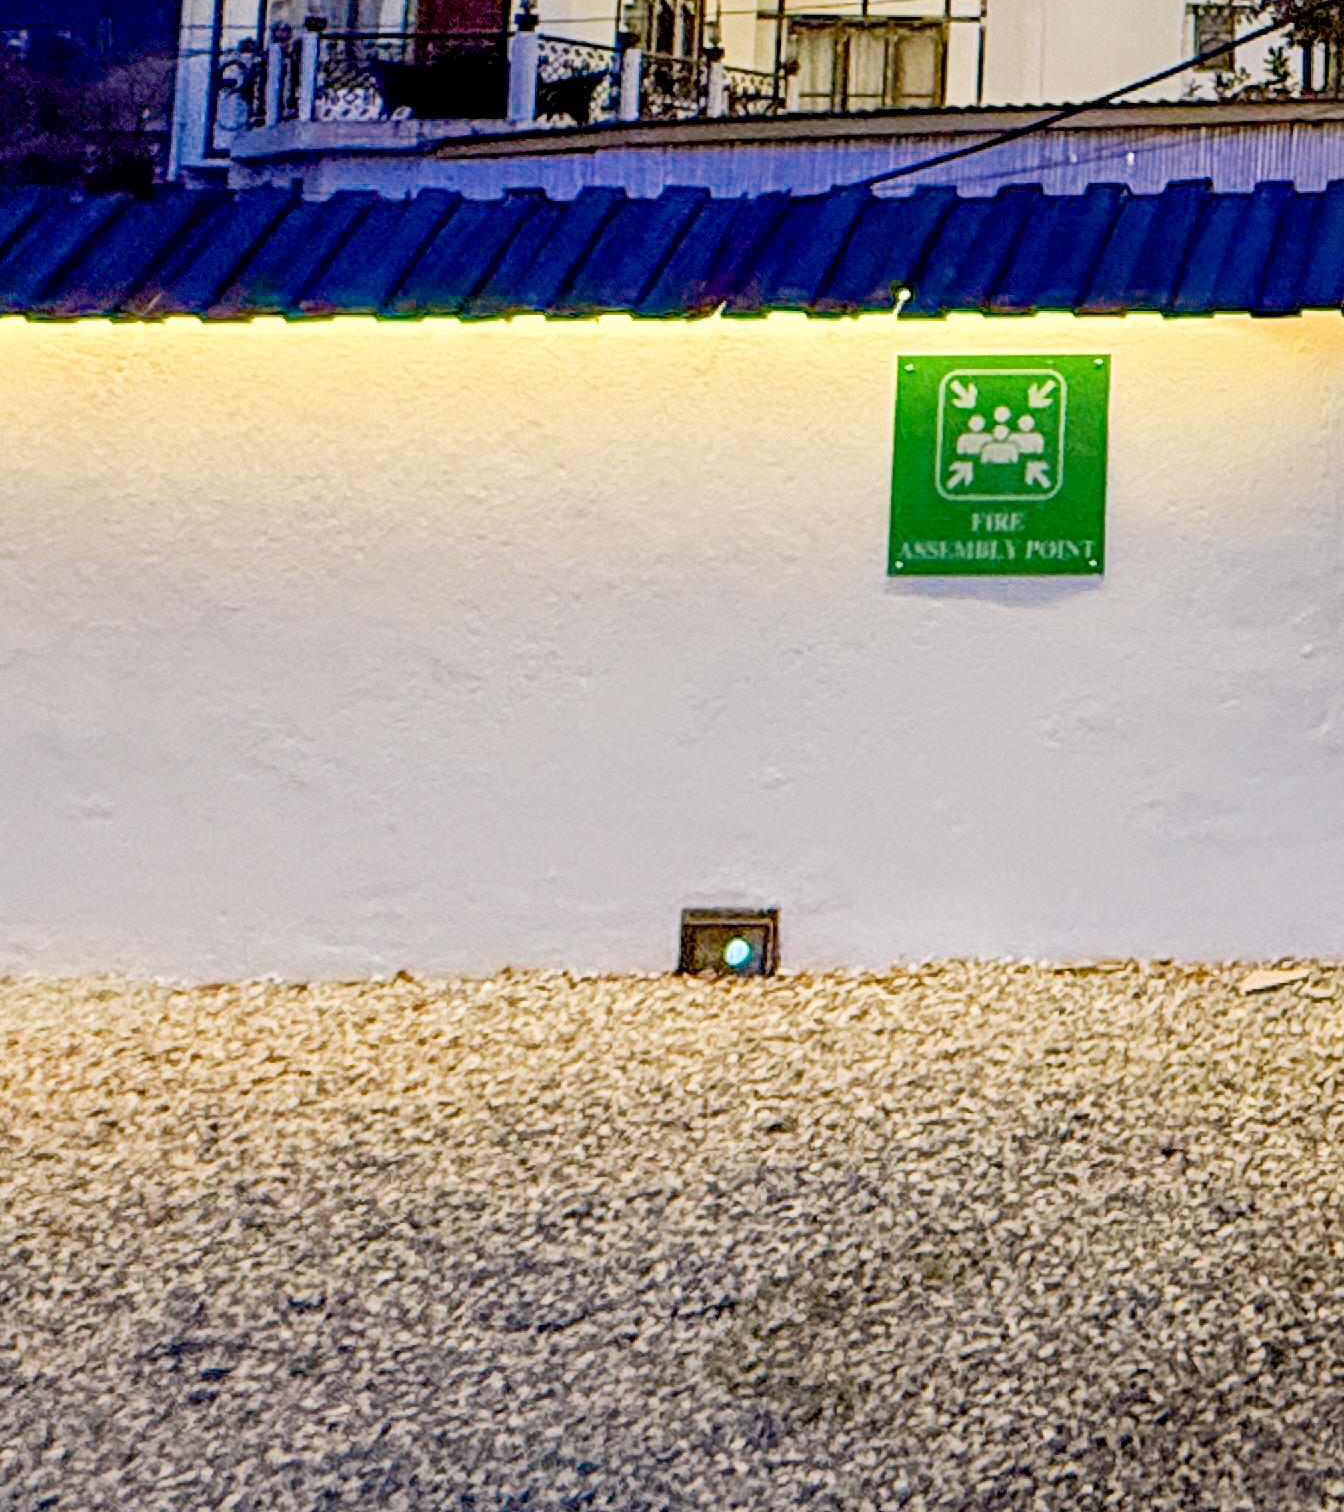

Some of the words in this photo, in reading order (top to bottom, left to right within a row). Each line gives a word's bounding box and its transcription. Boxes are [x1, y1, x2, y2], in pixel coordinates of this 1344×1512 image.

[971, 512, 1025, 533] FIRE
[899, 539, 1017, 561] ASSEMBLY
[1024, 538, 1096, 560] POINT
